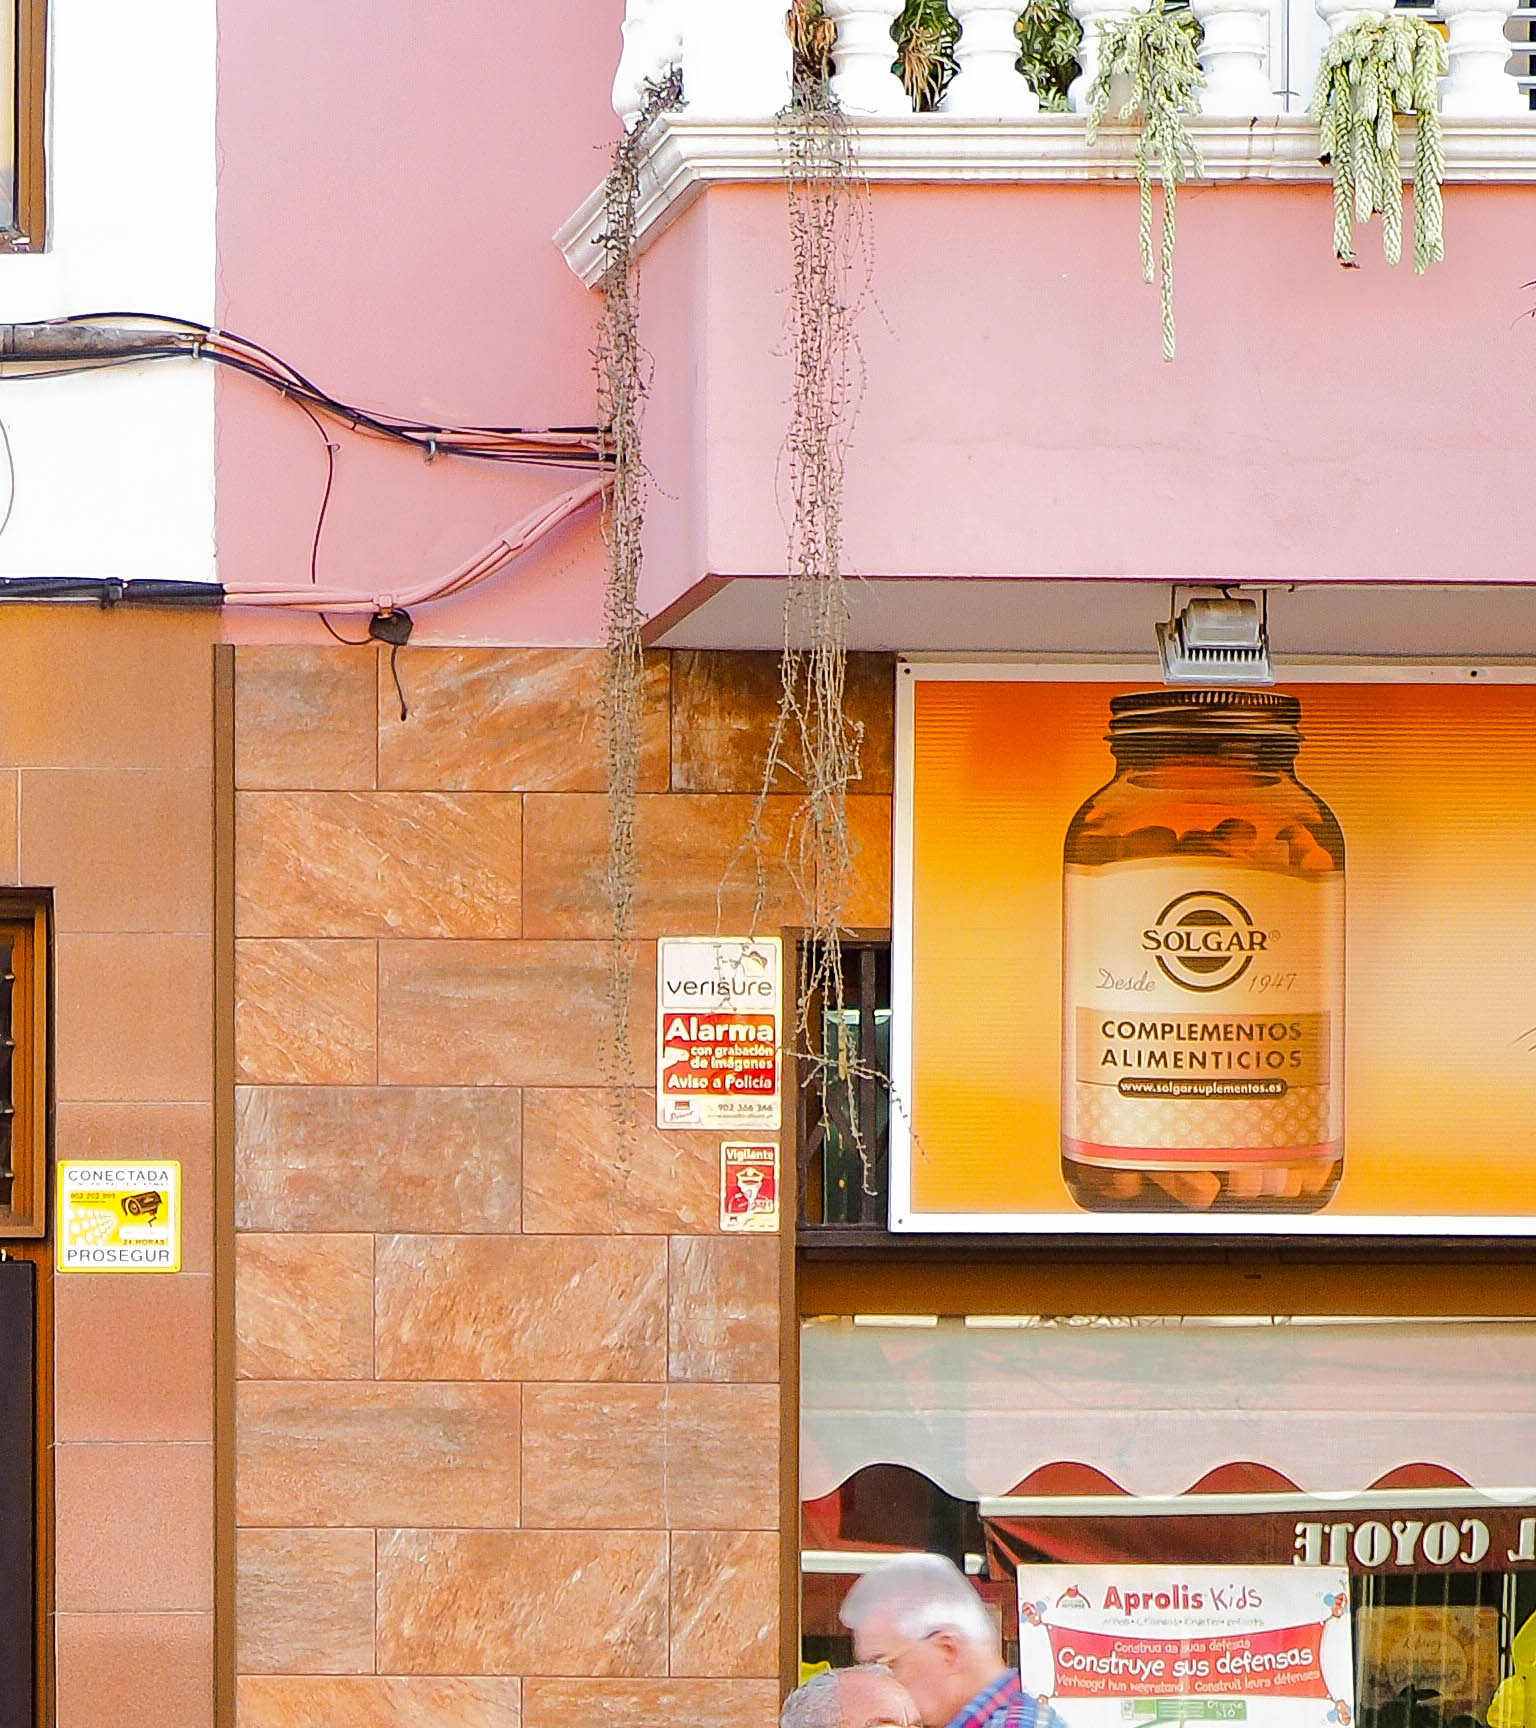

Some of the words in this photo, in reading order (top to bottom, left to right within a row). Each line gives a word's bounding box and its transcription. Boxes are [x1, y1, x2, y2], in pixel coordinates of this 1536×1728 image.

[1142, 929, 1268, 952] SOLGAR
[666, 977, 773, 998] verisure
[1096, 968, 1156, 993] Desde
[1247, 972, 1298, 993] 1947
[665, 1016, 775, 1043] Alarma
[1101, 1020, 1303, 1042] COMPLEMENTOS
[690, 1047, 712, 1057] con
[1100, 1049, 1303, 1070] ALIMENTICIOS
[690, 1056, 709, 1070] de
[667, 1074, 709, 1090] Aviso
[712, 1078, 722, 1090] a
[725, 1072, 773, 1090] Policía
[1120, 1080, 1283, 1097] www.solgarsuplementos.es
[68, 1170, 169, 1182] CONECTADA
[67, 1249, 170, 1262] PROSEGUR
[1103, 1583, 1203, 1616] Aprolis
[1212, 1583, 1263, 1612] Kids
[1057, 1647, 1165, 1681] Construye
[1172, 1657, 1210, 1678] sus
[1216, 1647, 1314, 1675] defensas
